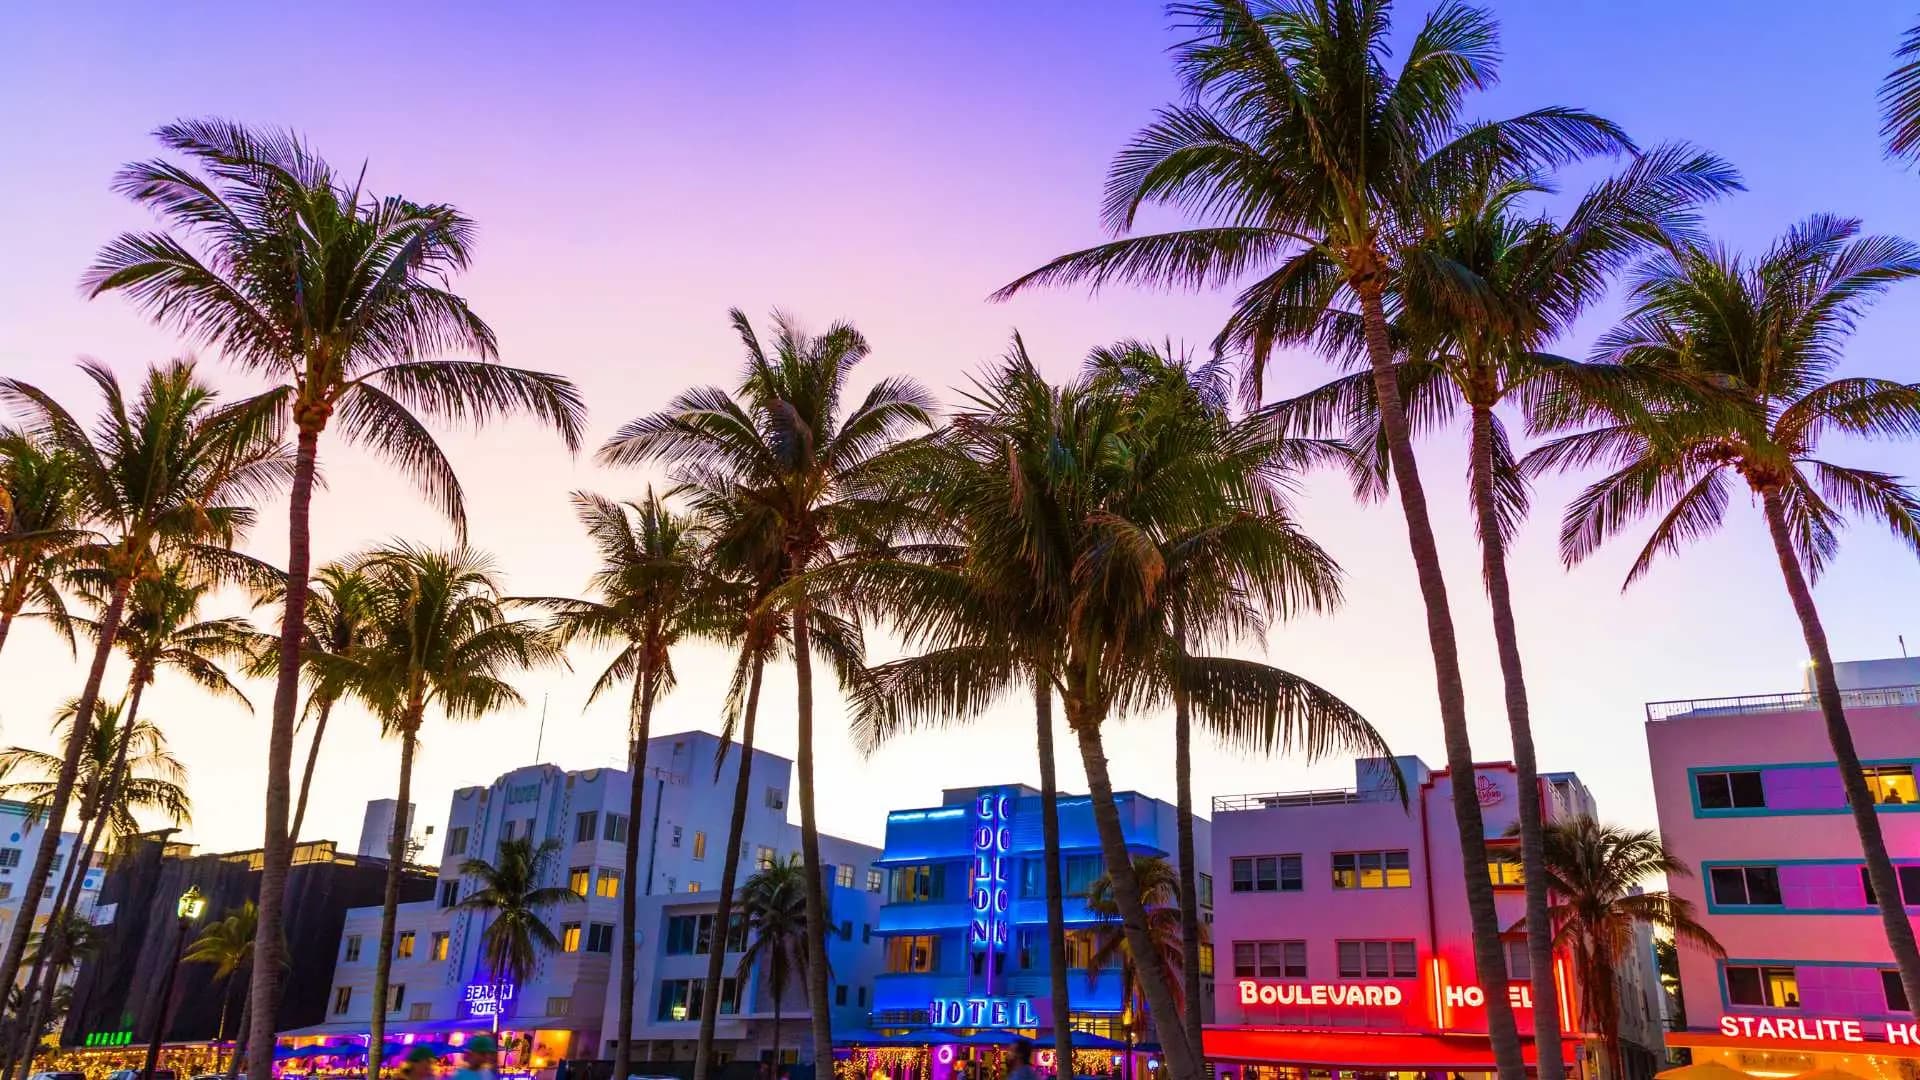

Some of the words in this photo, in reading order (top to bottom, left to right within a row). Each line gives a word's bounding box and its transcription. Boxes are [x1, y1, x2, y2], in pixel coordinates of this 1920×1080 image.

[465, 984, 513, 1001] BEACN
[1239, 981, 1402, 1006] BOULEVARD
[1446, 985, 1533, 1008] HOEL
[928, 999, 1038, 1027] HOTEL
[1720, 1016, 1864, 1042] STARLITE
